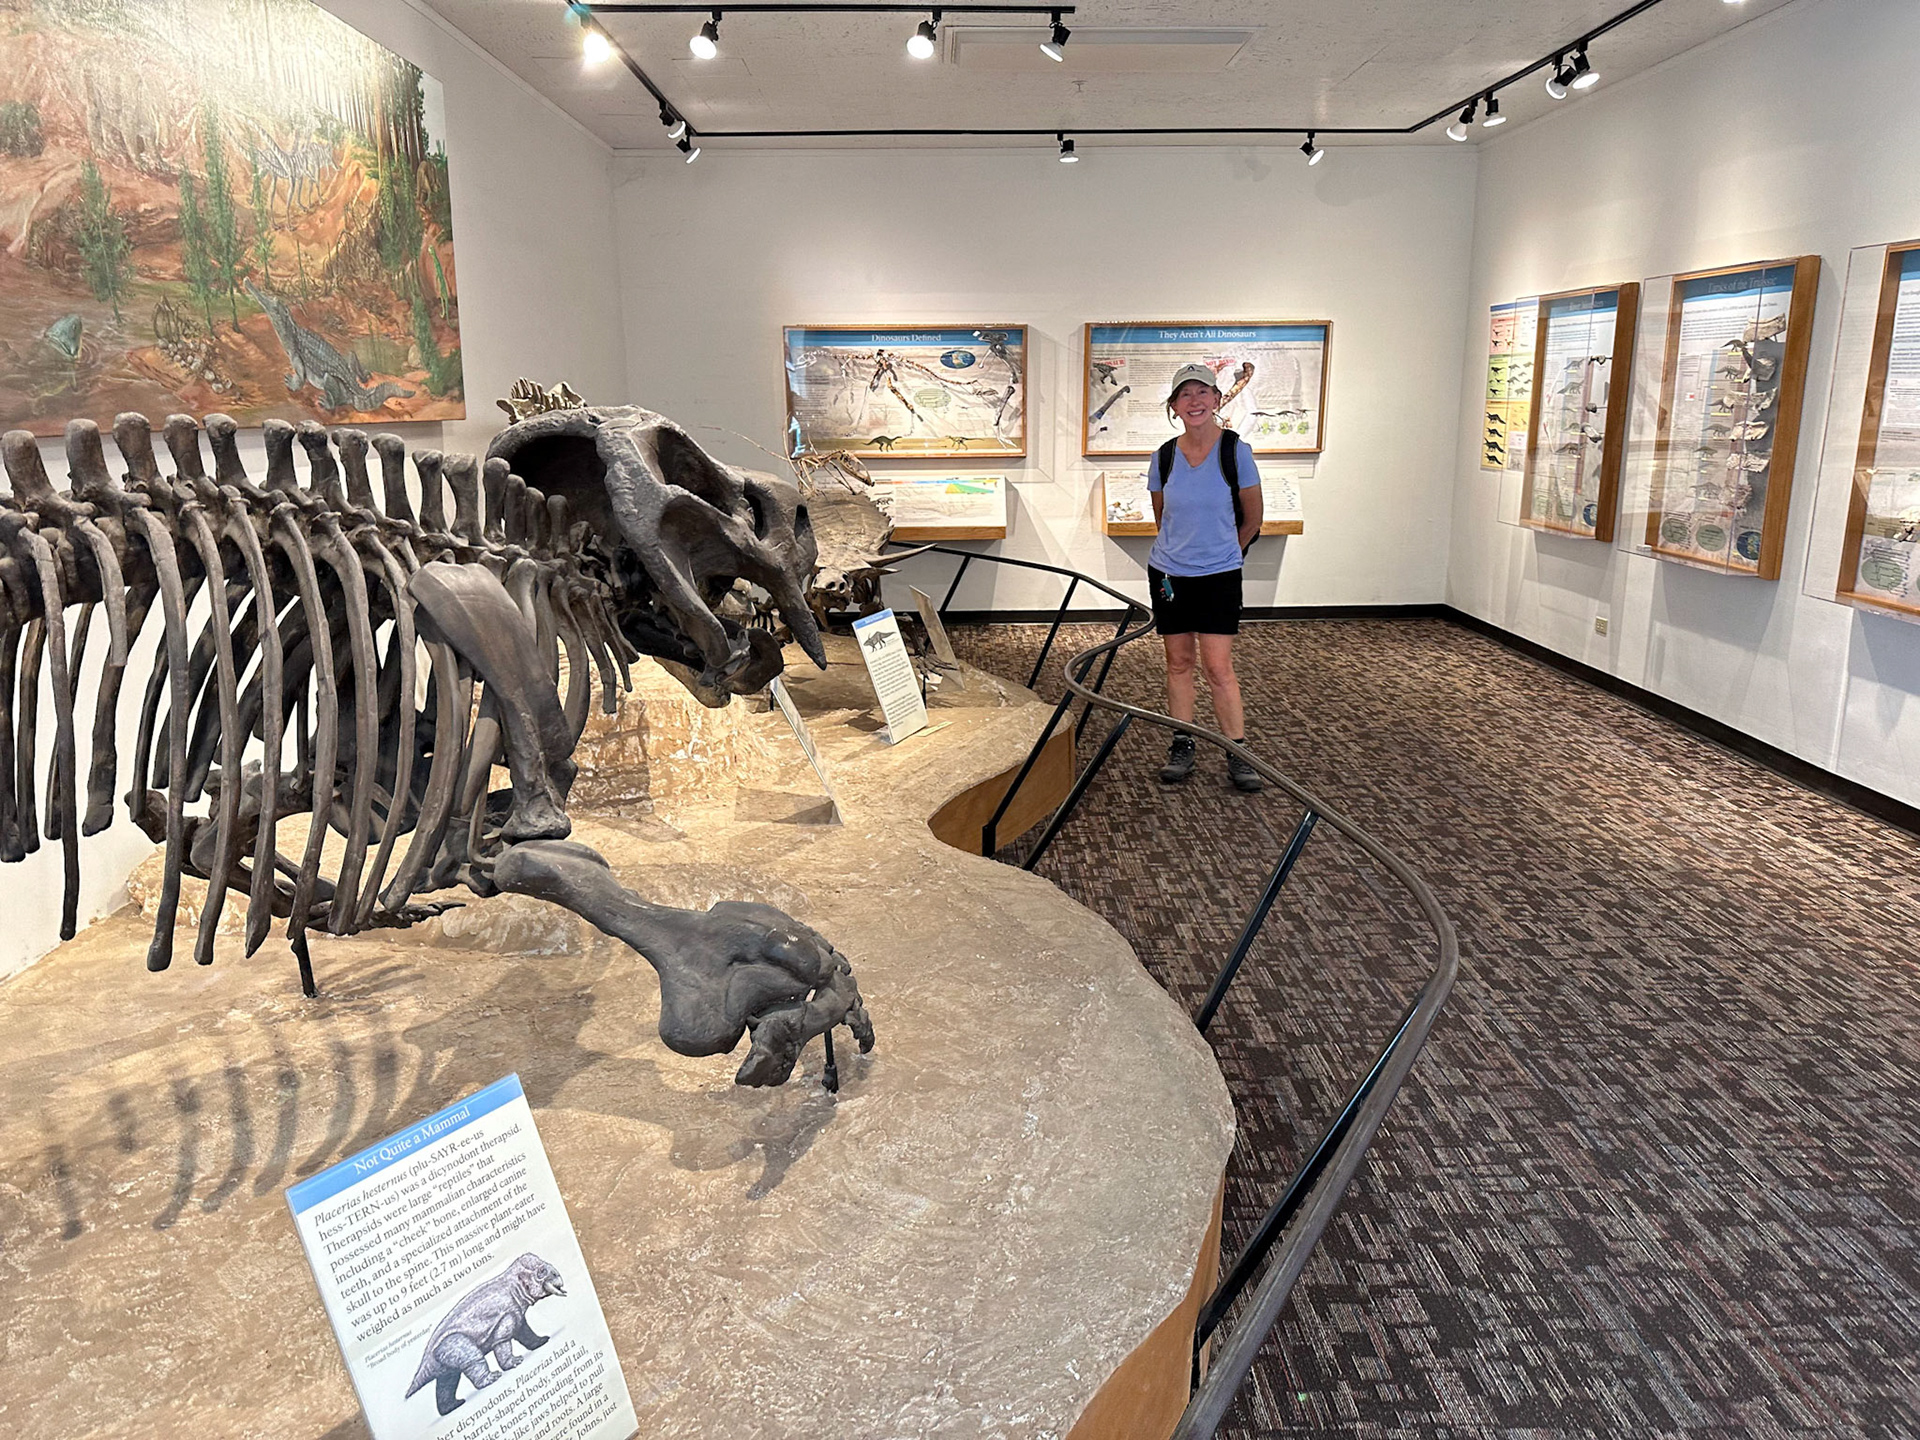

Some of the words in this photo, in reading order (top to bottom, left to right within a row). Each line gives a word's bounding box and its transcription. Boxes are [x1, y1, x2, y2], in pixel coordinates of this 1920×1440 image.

[871, 334, 910, 342] Dinosaurs
[911, 334, 942, 342] Defined
[1158, 330, 1178, 341] They
[1180, 330, 1203, 339] Aren't
[1205, 329, 1216, 338] All
[1217, 329, 1257, 339] Dinosaurs
[314, 1196, 362, 1227] Placerias
[362, 1171, 408, 1201] hesternus
[408, 1129, 485, 1177] (plu-SAYR-ee-us
[318, 1190, 400, 1242] hess-TERN-us)
[400, 1181, 420, 1196] was
[420, 1177, 428, 1186] a
[427, 1147, 480, 1182] dicynodont
[479, 1123, 522, 1153] therapsid.
[353, 1152, 379, 1175] Not
[378, 1135, 413, 1164] Quite
[412, 1134, 421, 1144] a
[420, 1105, 470, 1139] Mammal
[322, 1218, 383, 1255] Therapsids
[383, 1204, 408, 1222] were
[407, 1190, 433, 1209] large
[432, 1163, 475, 1192] “reptiles”
[476, 1154, 495, 1170] that
[329, 1232, 383, 1274] possessed
[383, 1218, 410, 1241] many
[411, 1188, 466, 1224] mammalian
[466, 1152, 527, 1192] characteristics
[334, 1251, 386, 1286] including
[385, 1247, 393, 1256] a
[392, 1220, 431, 1248] “cheek”
[432, 1209, 461, 1228] bone,
[460, 1181, 499, 1212] enlarged
[499, 1167, 527, 1189] canine
[340, 1277, 372, 1300] teeth,
[371, 1261, 392, 1282] and
[393, 1259, 401, 1269] a
[400, 1225, 453, 1265] specialized
[453, 1197, 503, 1233] attachment
[502, 1187, 513, 1202] of
[513, 1182, 528, 1196] the
[345, 1290, 372, 1315] skull
[371, 1286, 384, 1298] to
[384, 1275, 403, 1291] the
[403, 1258, 433, 1280] spine.
[431, 1243, 455, 1261] This
[454, 1222, 490, 1248] massive
[489, 1192, 535, 1230] plant-eater
[350, 1310, 372, 1328] was
[372, 1301, 388, 1315] up
[388, 1294, 400, 1306] to
[400, 1286, 408, 1298] 9
[409, 1275, 429, 1293] feet
[429, 1261, 447, 1282] (2.7
[448, 1253, 463, 1269] m)
[462, 1241, 485, 1260] long
[484, 1227, 502, 1246] and
[501, 1214, 527, 1235] might
[525, 1202, 546, 1219] have
[356, 1308, 401, 1342] weighed
[401, 1303, 413, 1316] as
[413, 1284, 442, 1308] much
[442, 1277, 453, 1290] as
[452, 1266, 472, 1282] two
[471, 1252, 495, 1270] tons.
[455, 1386, 516, 1434] dicynodonts,
[515, 1355, 554, 1390] Placerias
[552, 1341, 570, 1361] had
[570, 1339, 577, 1348] a
[499, 1409, 528, 1435] bones
[527, 1373, 575, 1417] protruding
[572, 1358, 594, 1378] from
[593, 1350, 604, 1362] its
[525, 1375, 551, 1398] body,
[550, 1355, 573, 1380] small
[572, 1344, 589, 1362] tail,
[529, 1408, 551, 1432] jaws
[549, 1383, 579, 1413] helped
[578, 1378, 589, 1390] to
[588, 1362, 605, 1385] pull
[534, 1421, 552, 1440] and
[551, 1405, 576, 1429] roots.
[576, 1397, 584, 1409] A
[582, 1382, 604, 1403] large
[568, 1403, 594, 1431] found
[593, 1398, 603, 1411] in
[602, 1393, 609, 1403] a
[576, 1415, 603, 1440] Johns,
[601, 1401, 618, 1421] just
